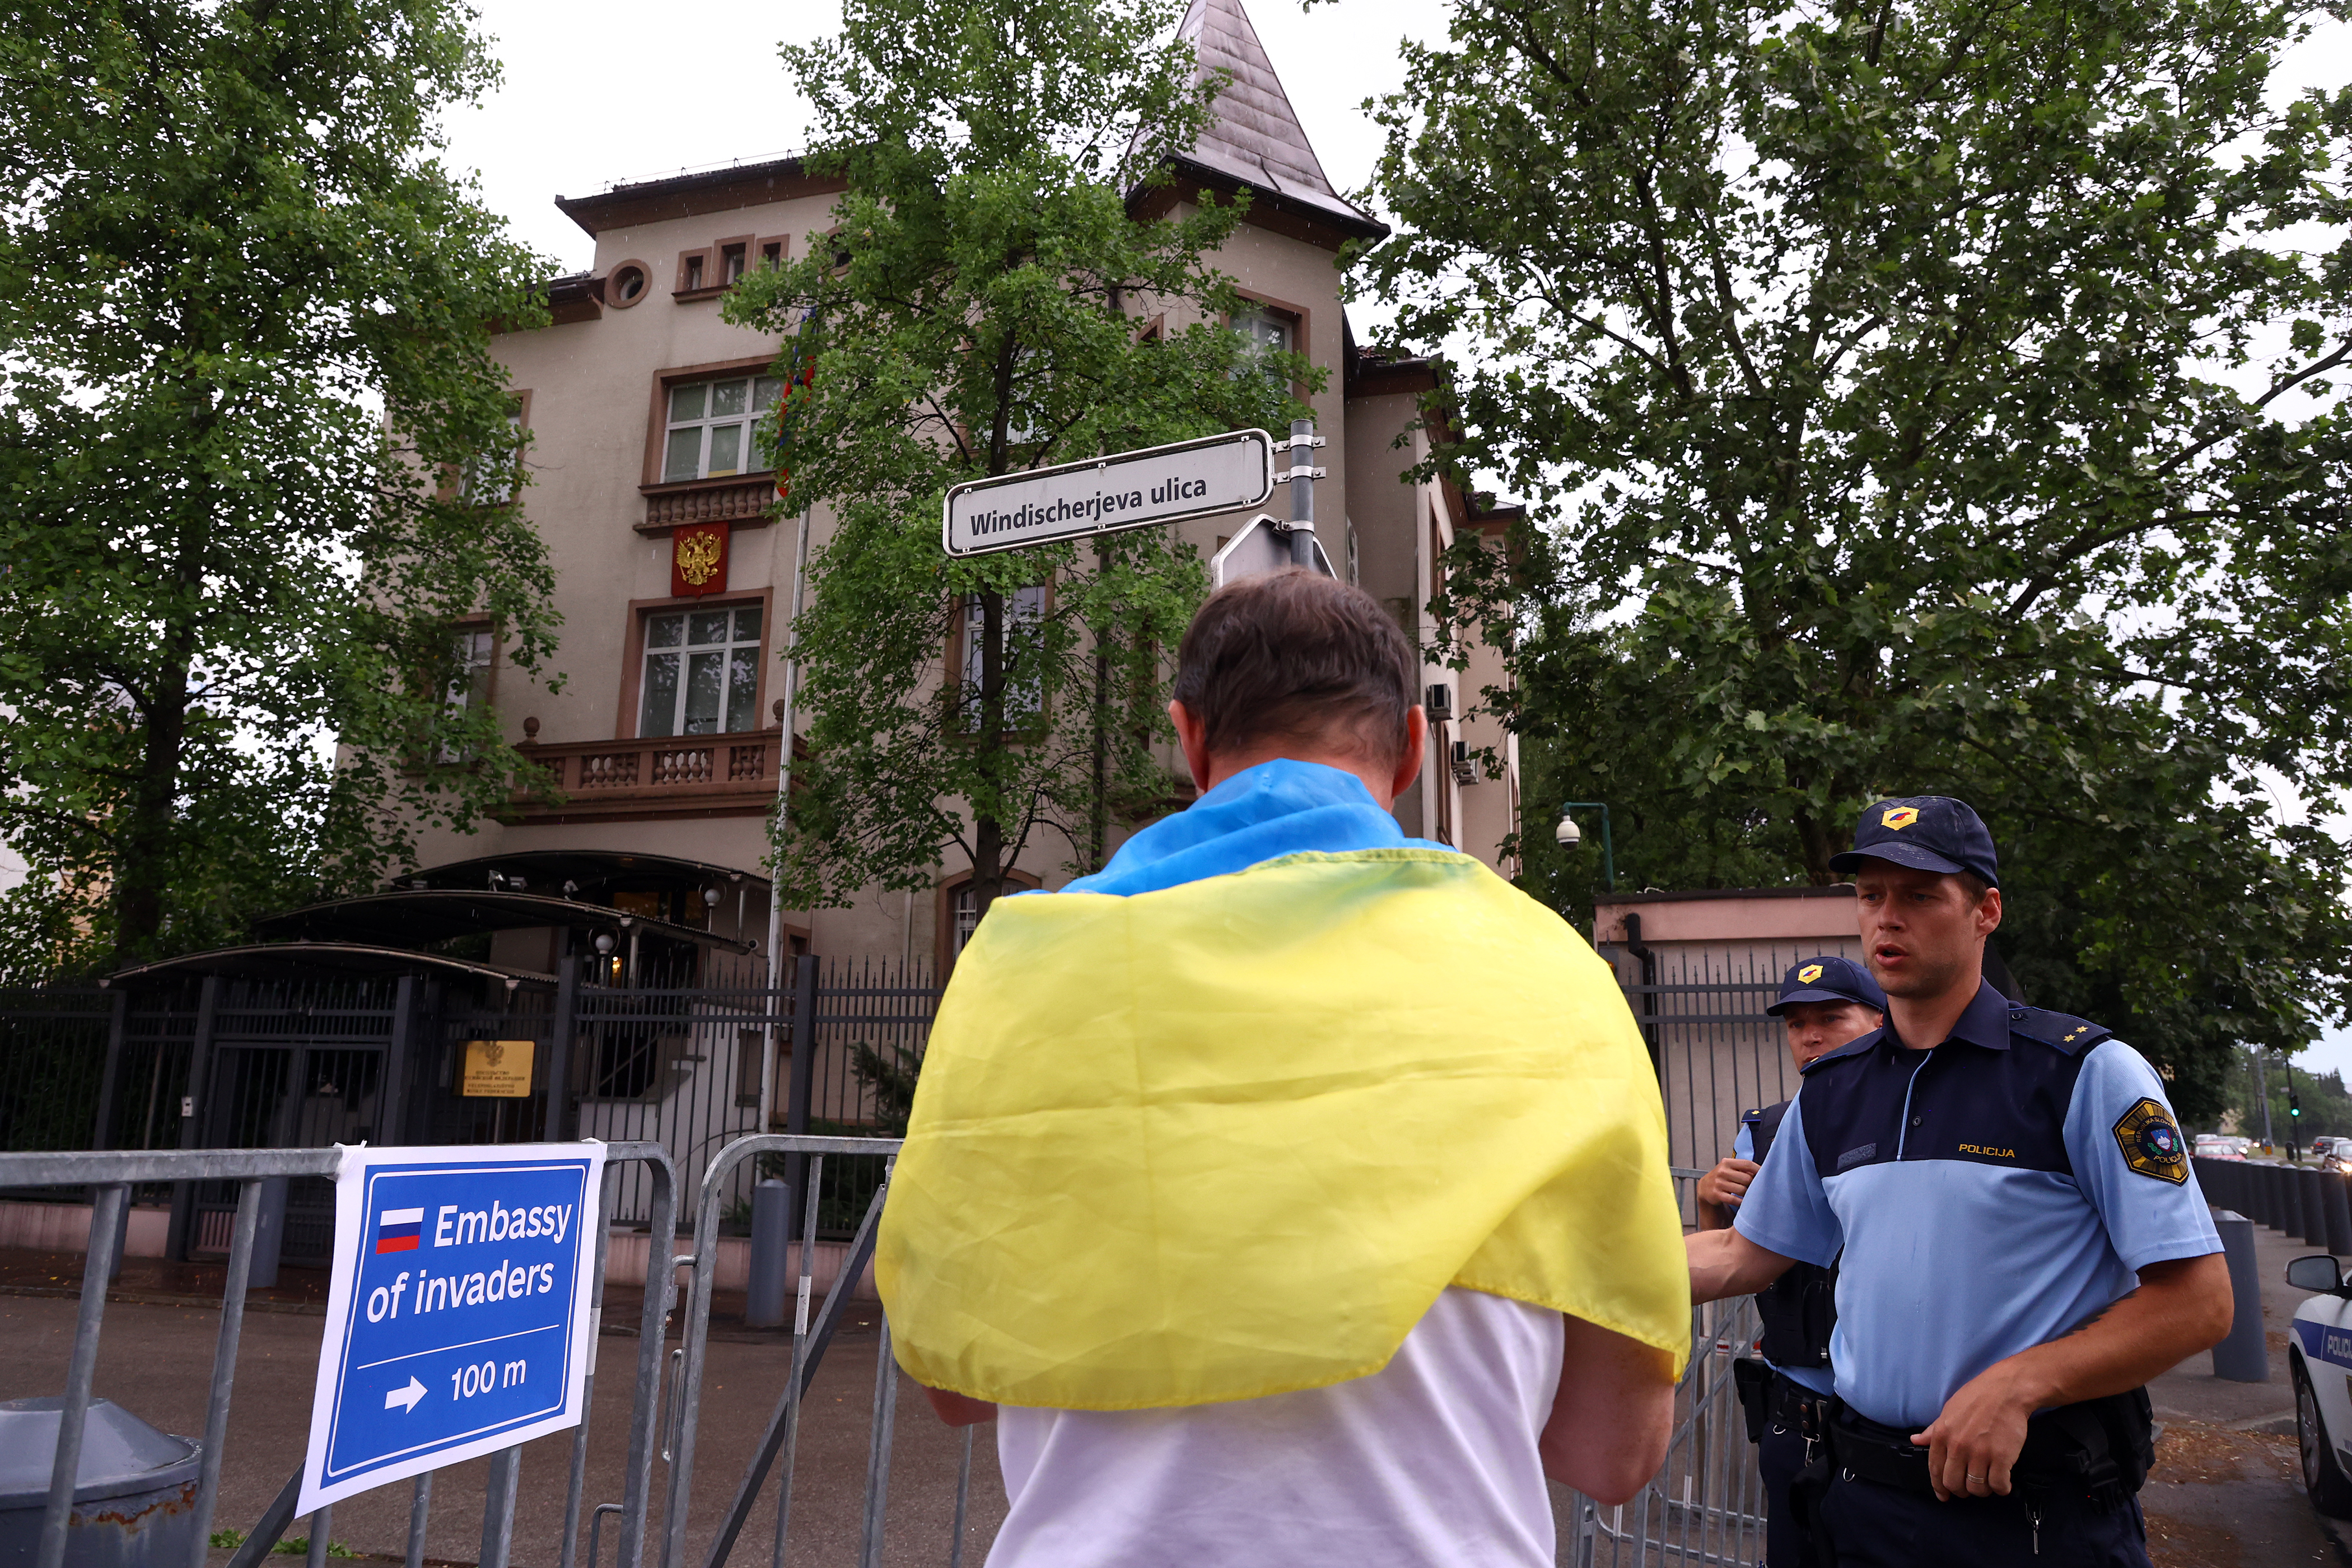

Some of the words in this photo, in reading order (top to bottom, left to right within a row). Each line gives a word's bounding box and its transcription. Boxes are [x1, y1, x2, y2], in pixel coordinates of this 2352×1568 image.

[970, 490, 1142, 536] Windischerjeva
[1151, 477, 1206, 508] ulica
[1958, 1143, 2015, 1158] POLICIJA
[2153, 1152, 2182, 1164] POLICIJA
[433, 1200, 572, 1247] Embassy
[367, 1272, 410, 1323] of
[414, 1259, 554, 1315] invaders
[2327, 1334, 2352, 1360] POLICI
[451, 1360, 496, 1401] 100
[502, 1359, 526, 1388] m
